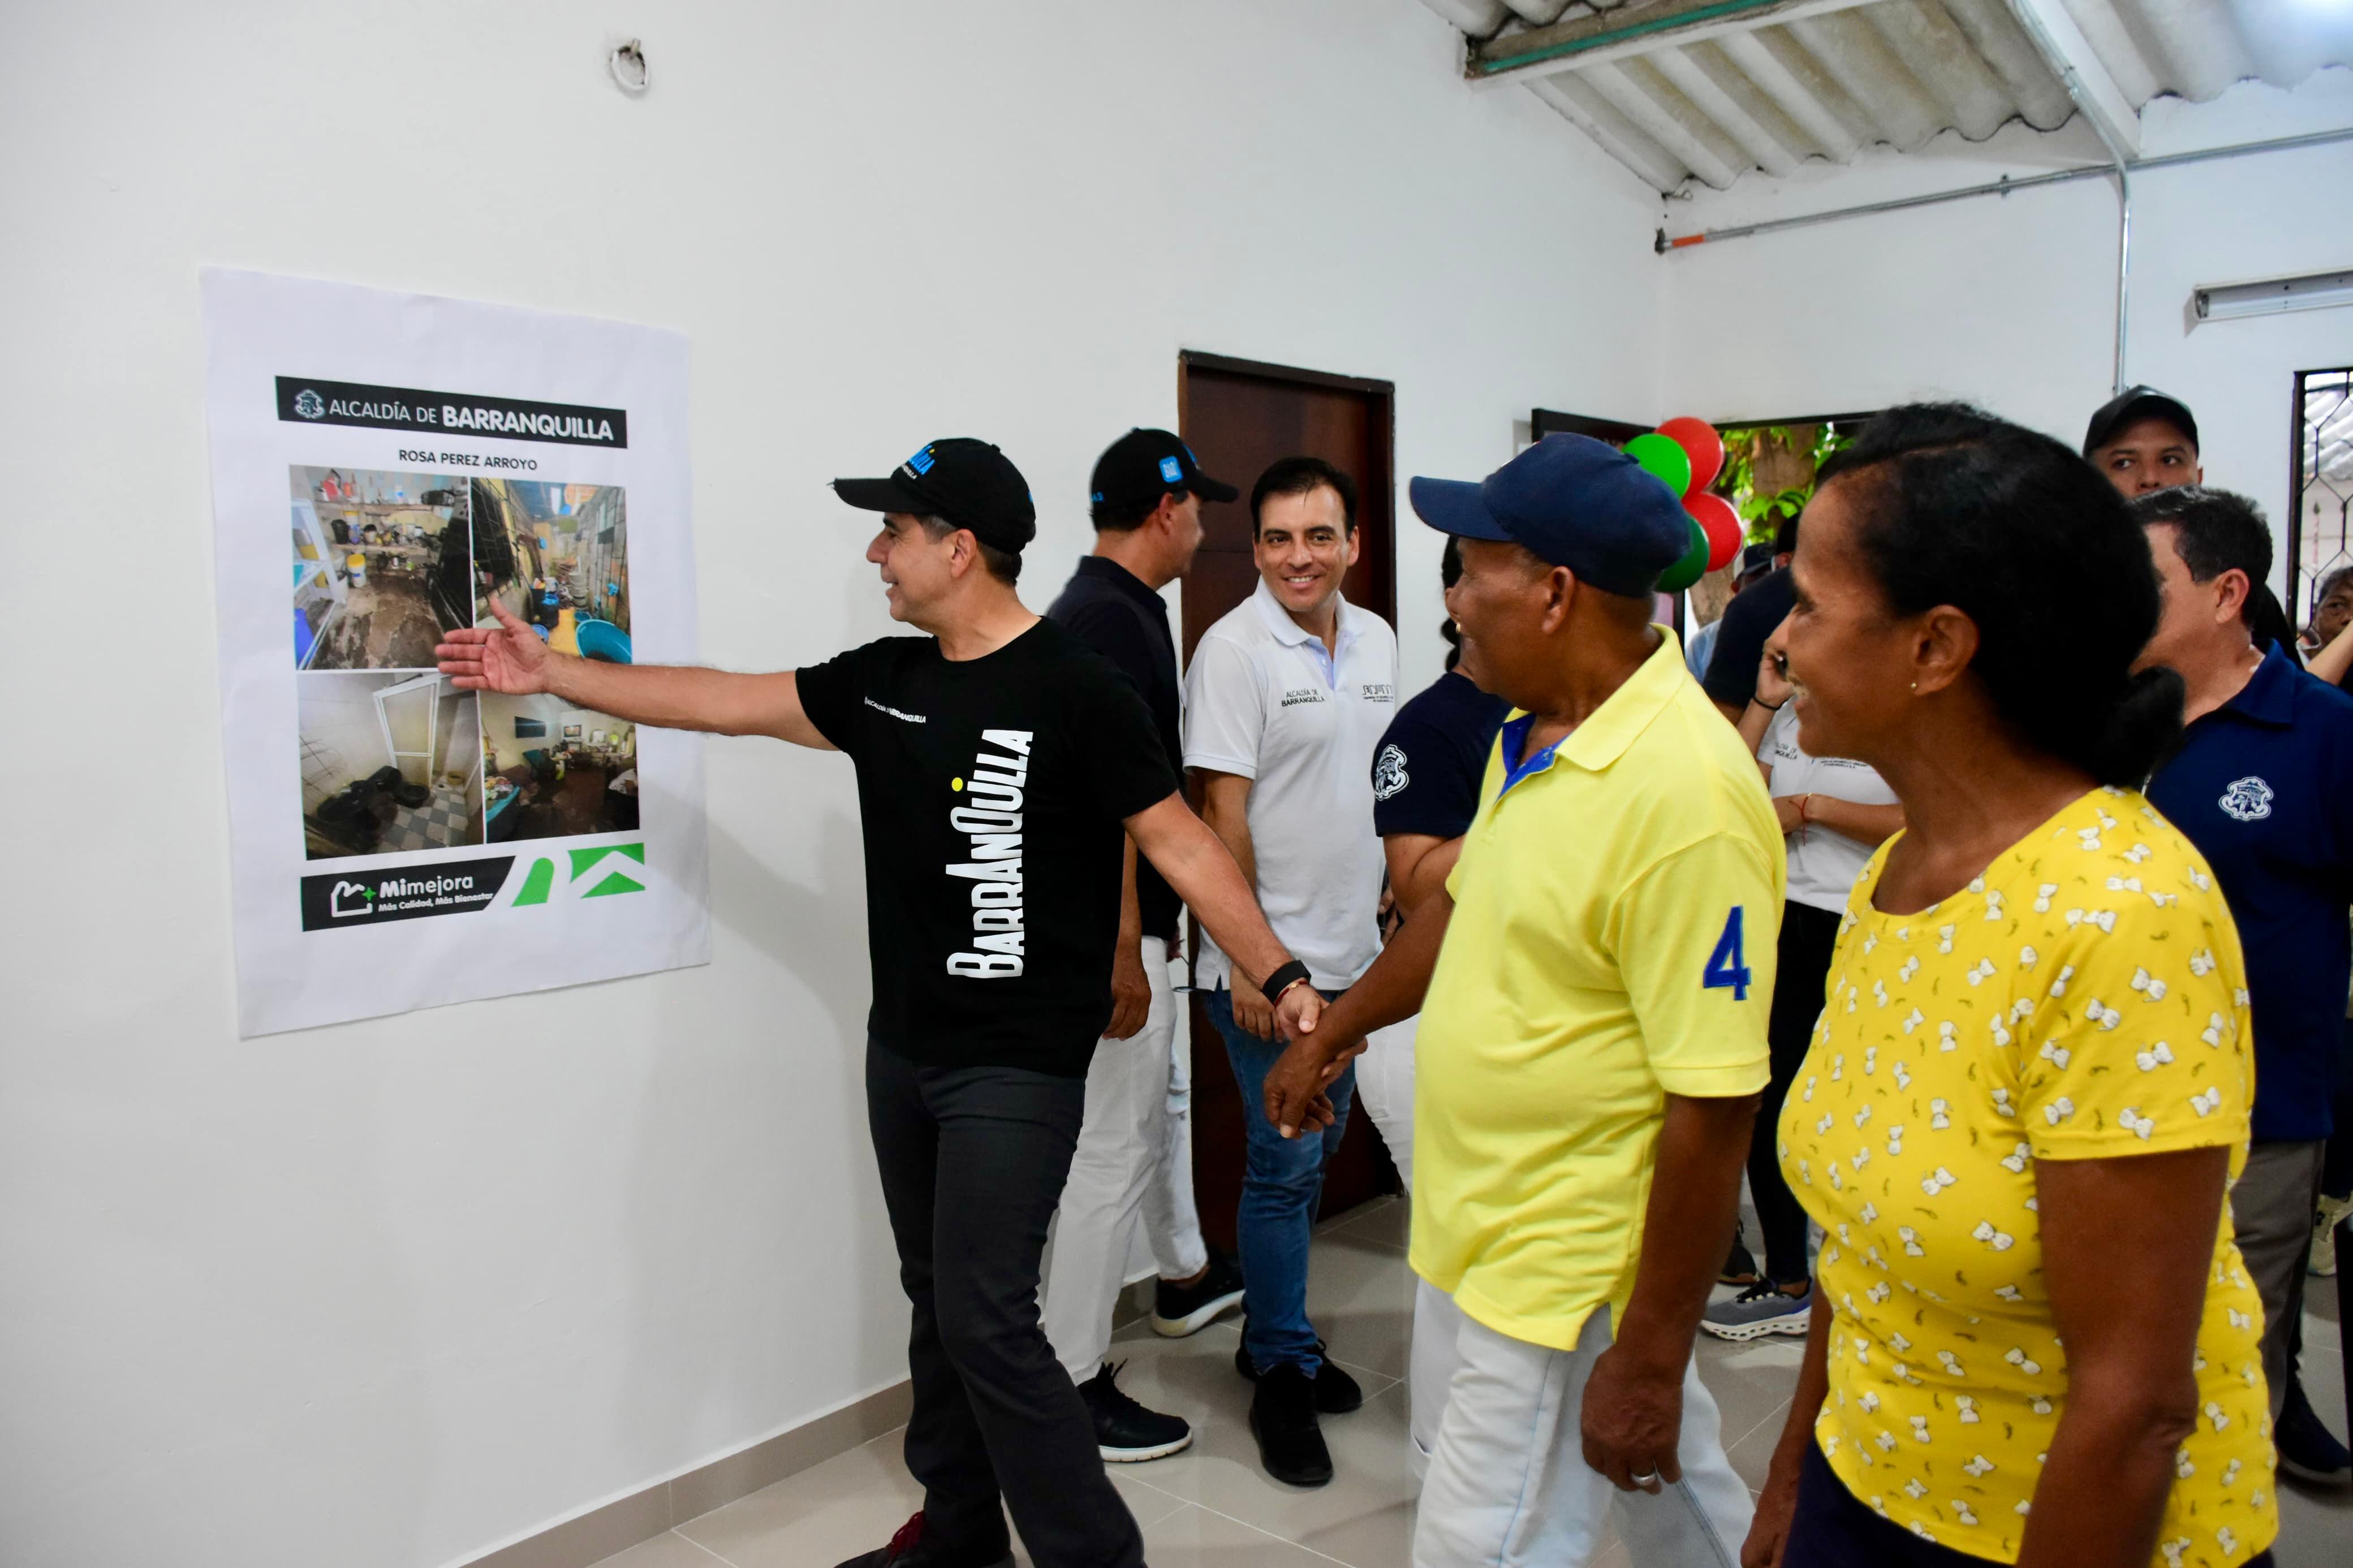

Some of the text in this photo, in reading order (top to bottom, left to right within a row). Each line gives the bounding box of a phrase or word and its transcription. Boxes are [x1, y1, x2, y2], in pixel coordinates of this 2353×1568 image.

[329, 399, 614, 440] ALCALDÍA DE BARRANQUILLA
[399, 450, 537, 470] ROSA PEREZ ARROYO
[1281, 696, 1325, 707] BARRANQUILLA
[380, 875, 473, 899] Mimejora
[378, 892, 494, 912] Más Calidad, Más Bienestar
[1703, 905, 1751, 1000] 4
